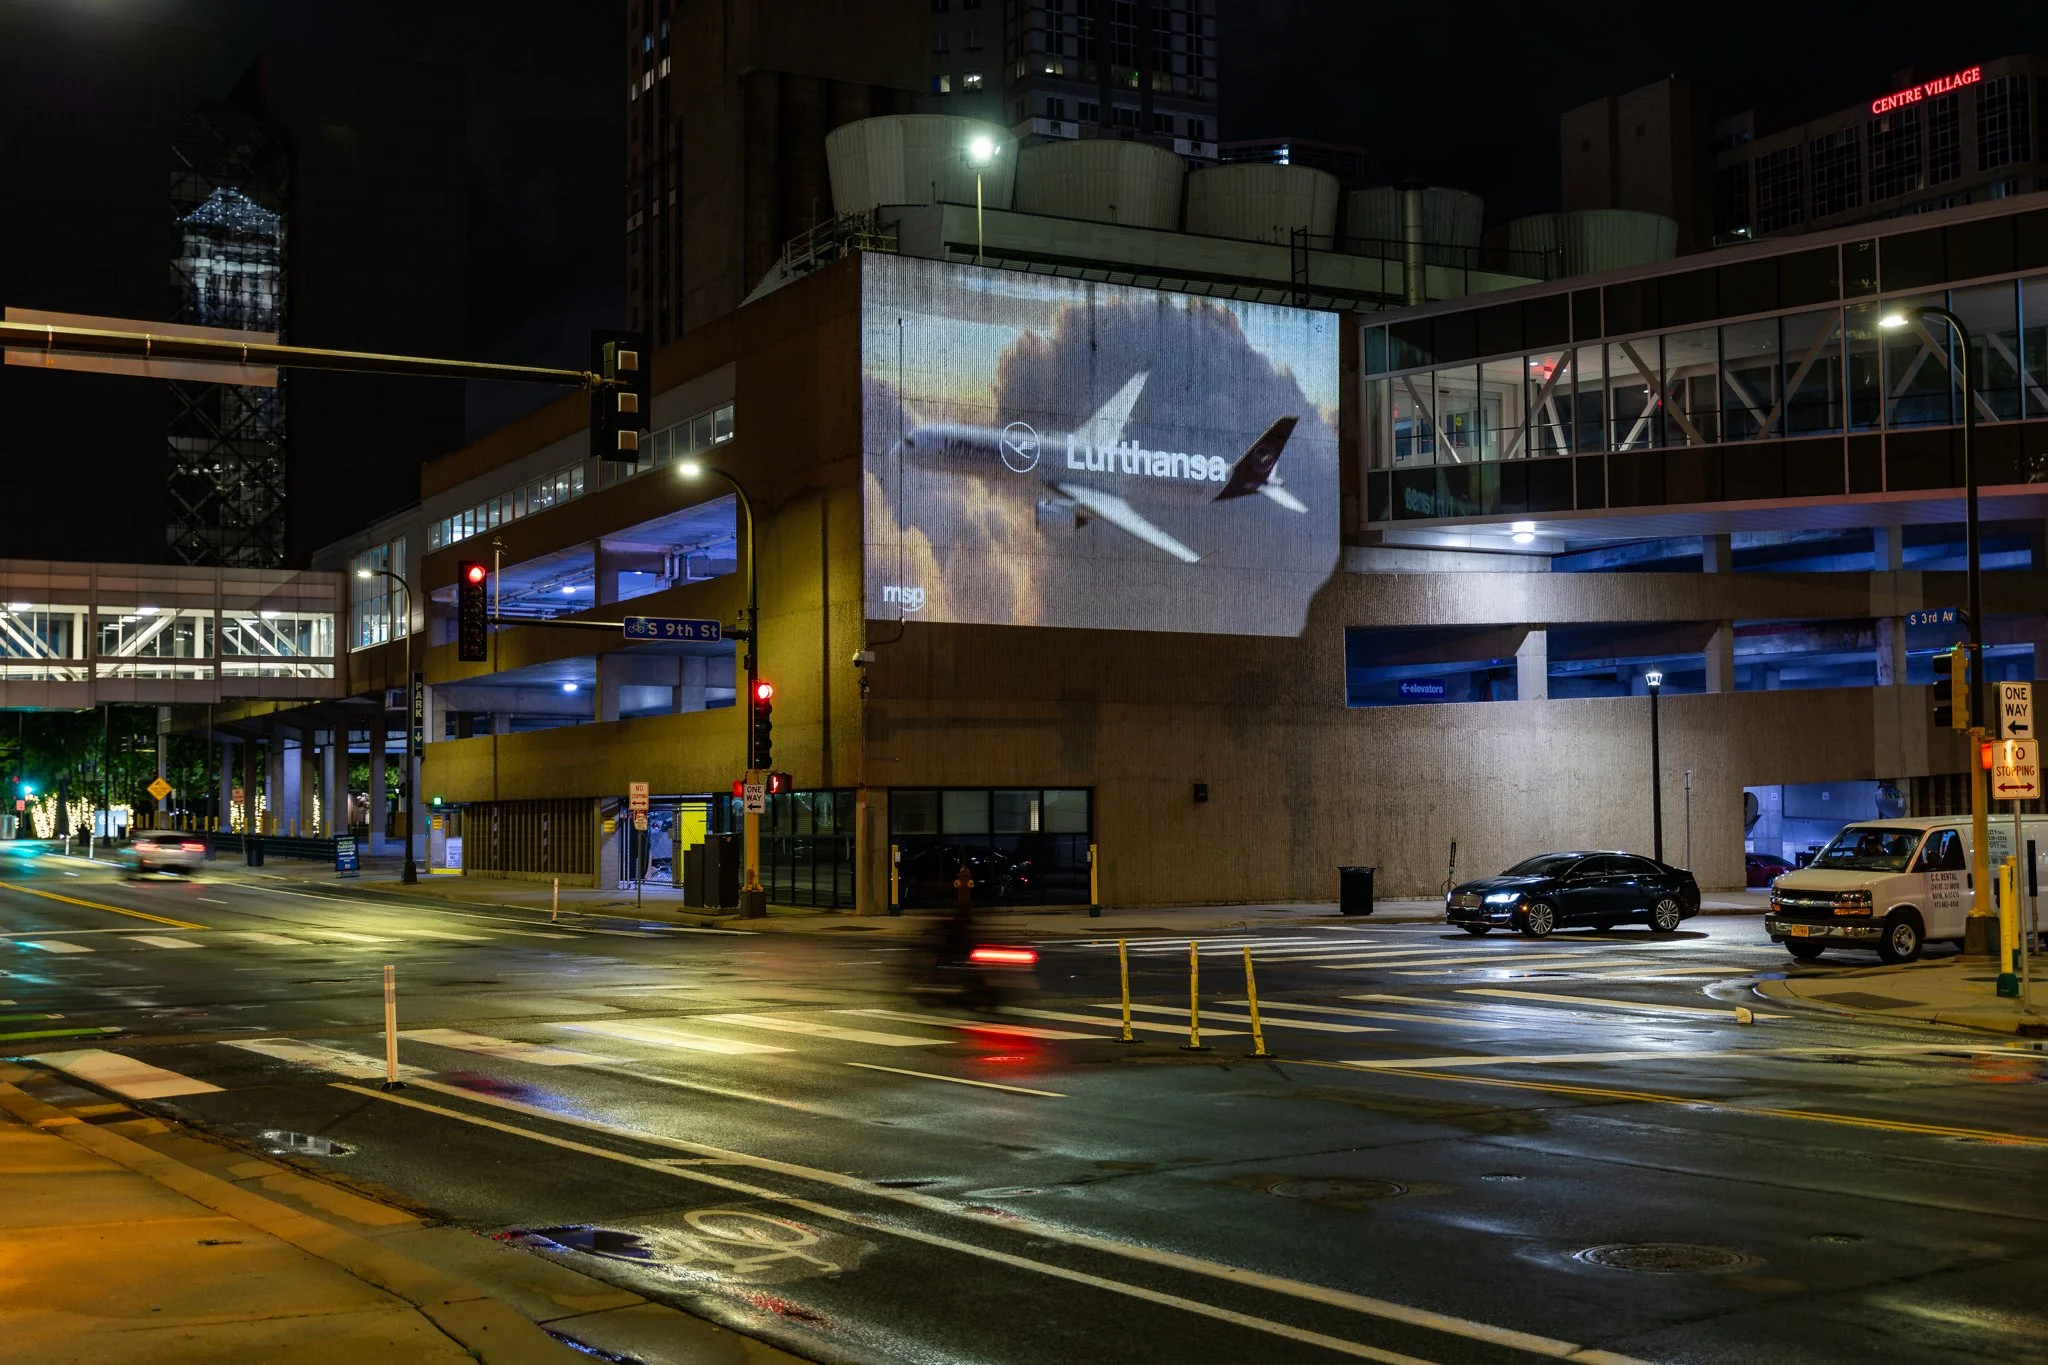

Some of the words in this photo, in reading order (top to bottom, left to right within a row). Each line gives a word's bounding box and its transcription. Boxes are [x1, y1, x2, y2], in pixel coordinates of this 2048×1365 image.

[1872, 86, 1922, 114] CENTRE
[1924, 66, 1980, 96] VILLAGE
[1066, 434, 1226, 482] Lufthansa
[882, 586, 925, 608] msp
[1910, 614, 1916, 625] S
[1921, 612, 1938, 624] 3rd
[1942, 611, 1954, 622] Av
[648, 622, 658, 635] S
[665, 623, 693, 637] 9th
[700, 624, 718, 638] St
[1409, 683, 1444, 693] elevators
[2005, 687, 2028, 700] ONE
[415, 682, 423, 718] PARK
[2005, 703, 2028, 717] WAY
[1996, 765, 2035, 777] STOPPING
[746, 794, 762, 802] WAY
